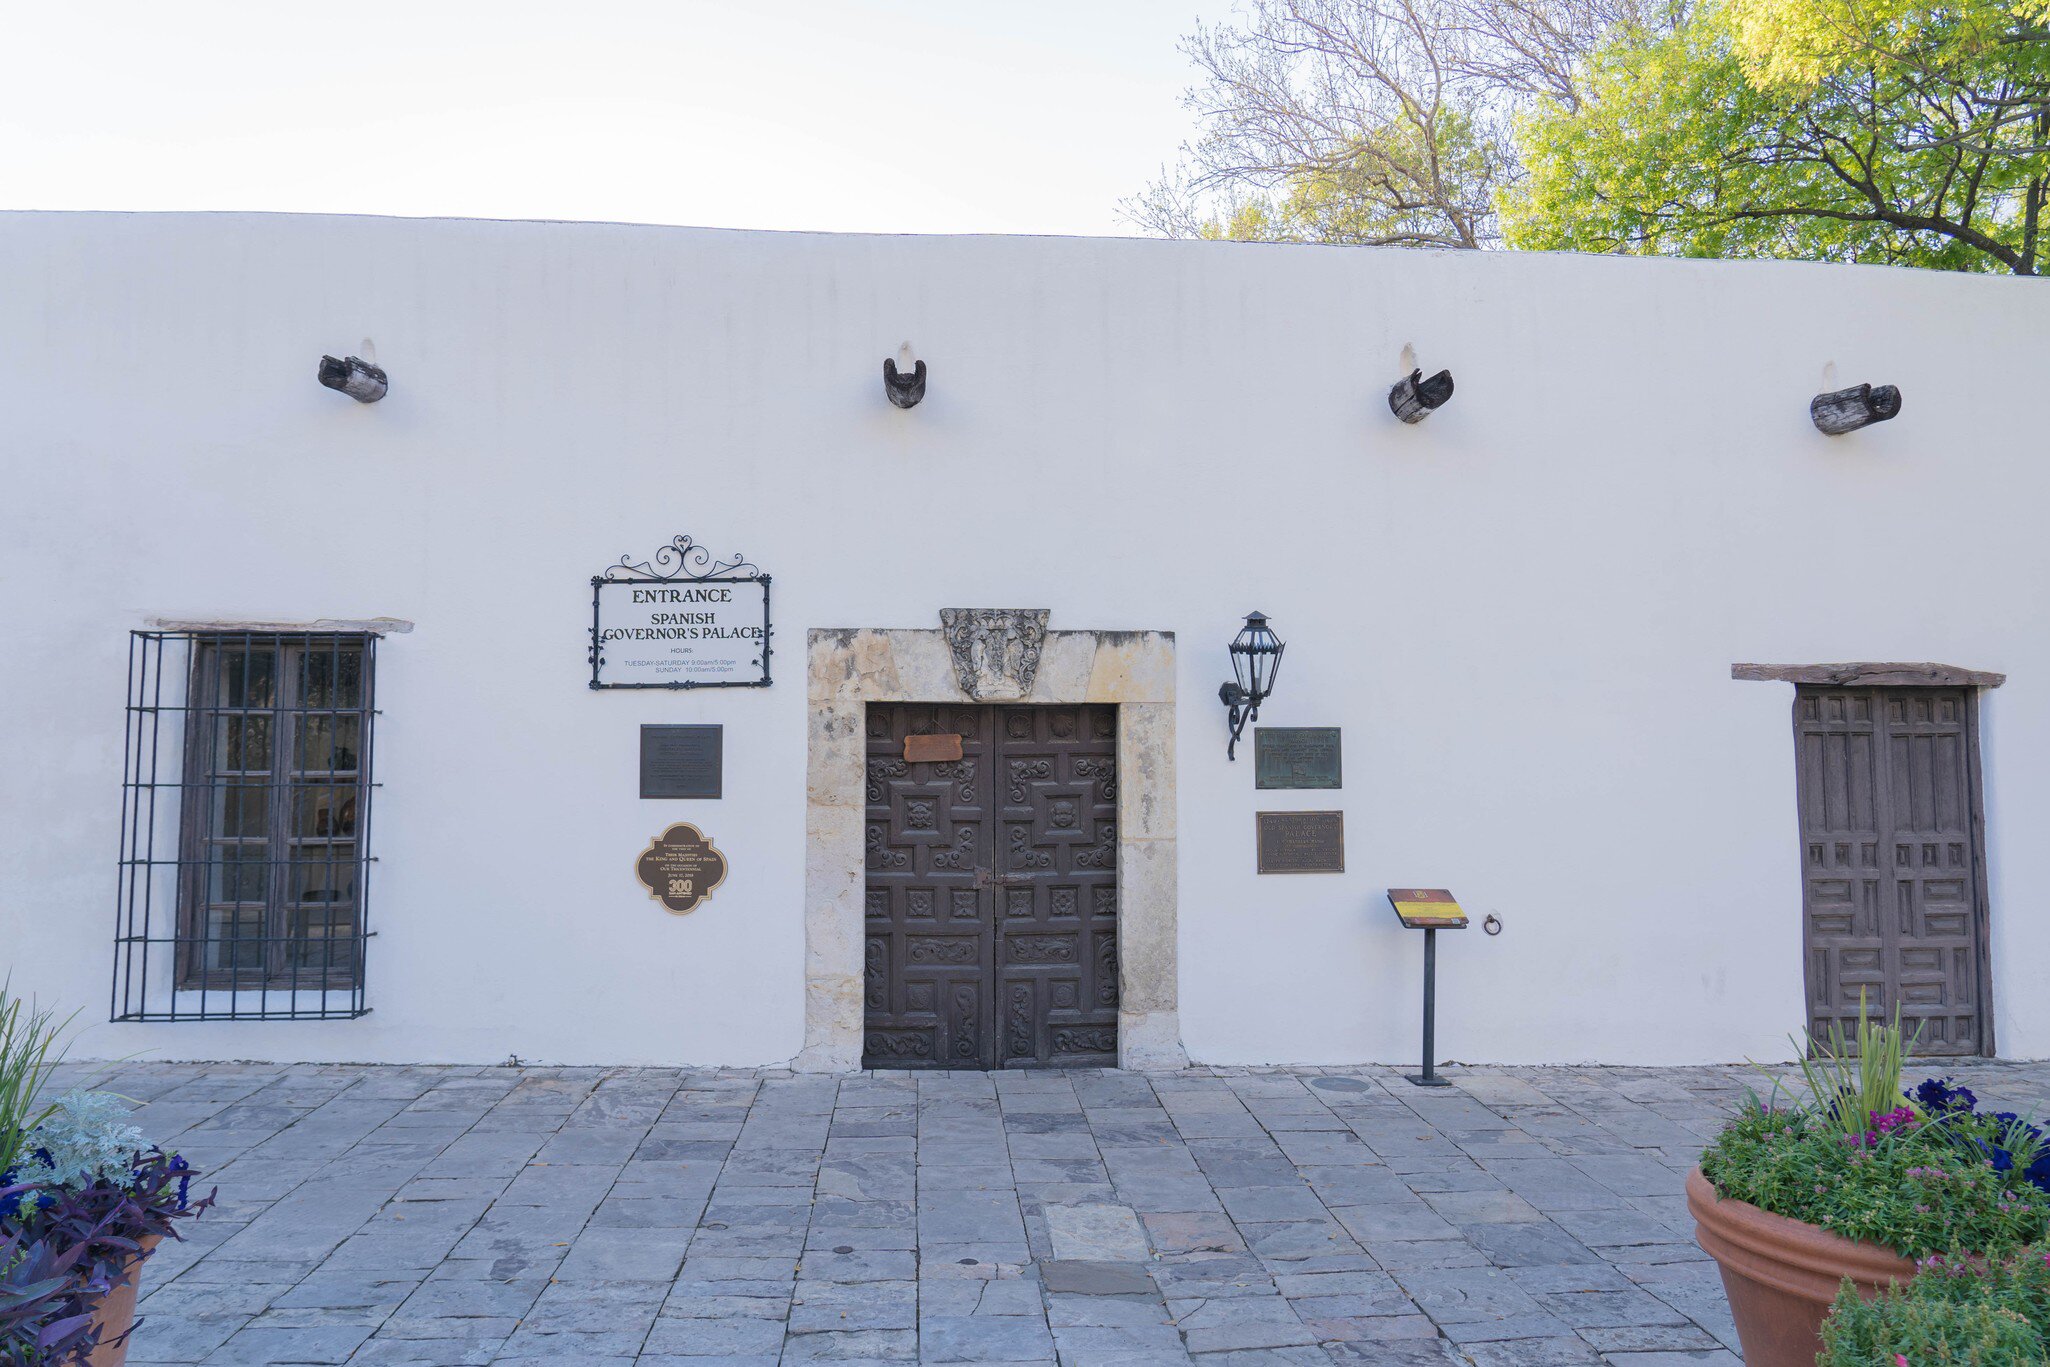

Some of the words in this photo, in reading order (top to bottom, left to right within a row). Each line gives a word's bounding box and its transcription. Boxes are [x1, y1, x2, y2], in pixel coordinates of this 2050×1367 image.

[632, 588, 732, 604] ENTRANCE
[650, 613, 715, 625] SPANISH
[603, 627, 699, 641] GOVERNOR'S
[702, 627, 760, 640] PALACE
[668, 879, 693, 893] 300
